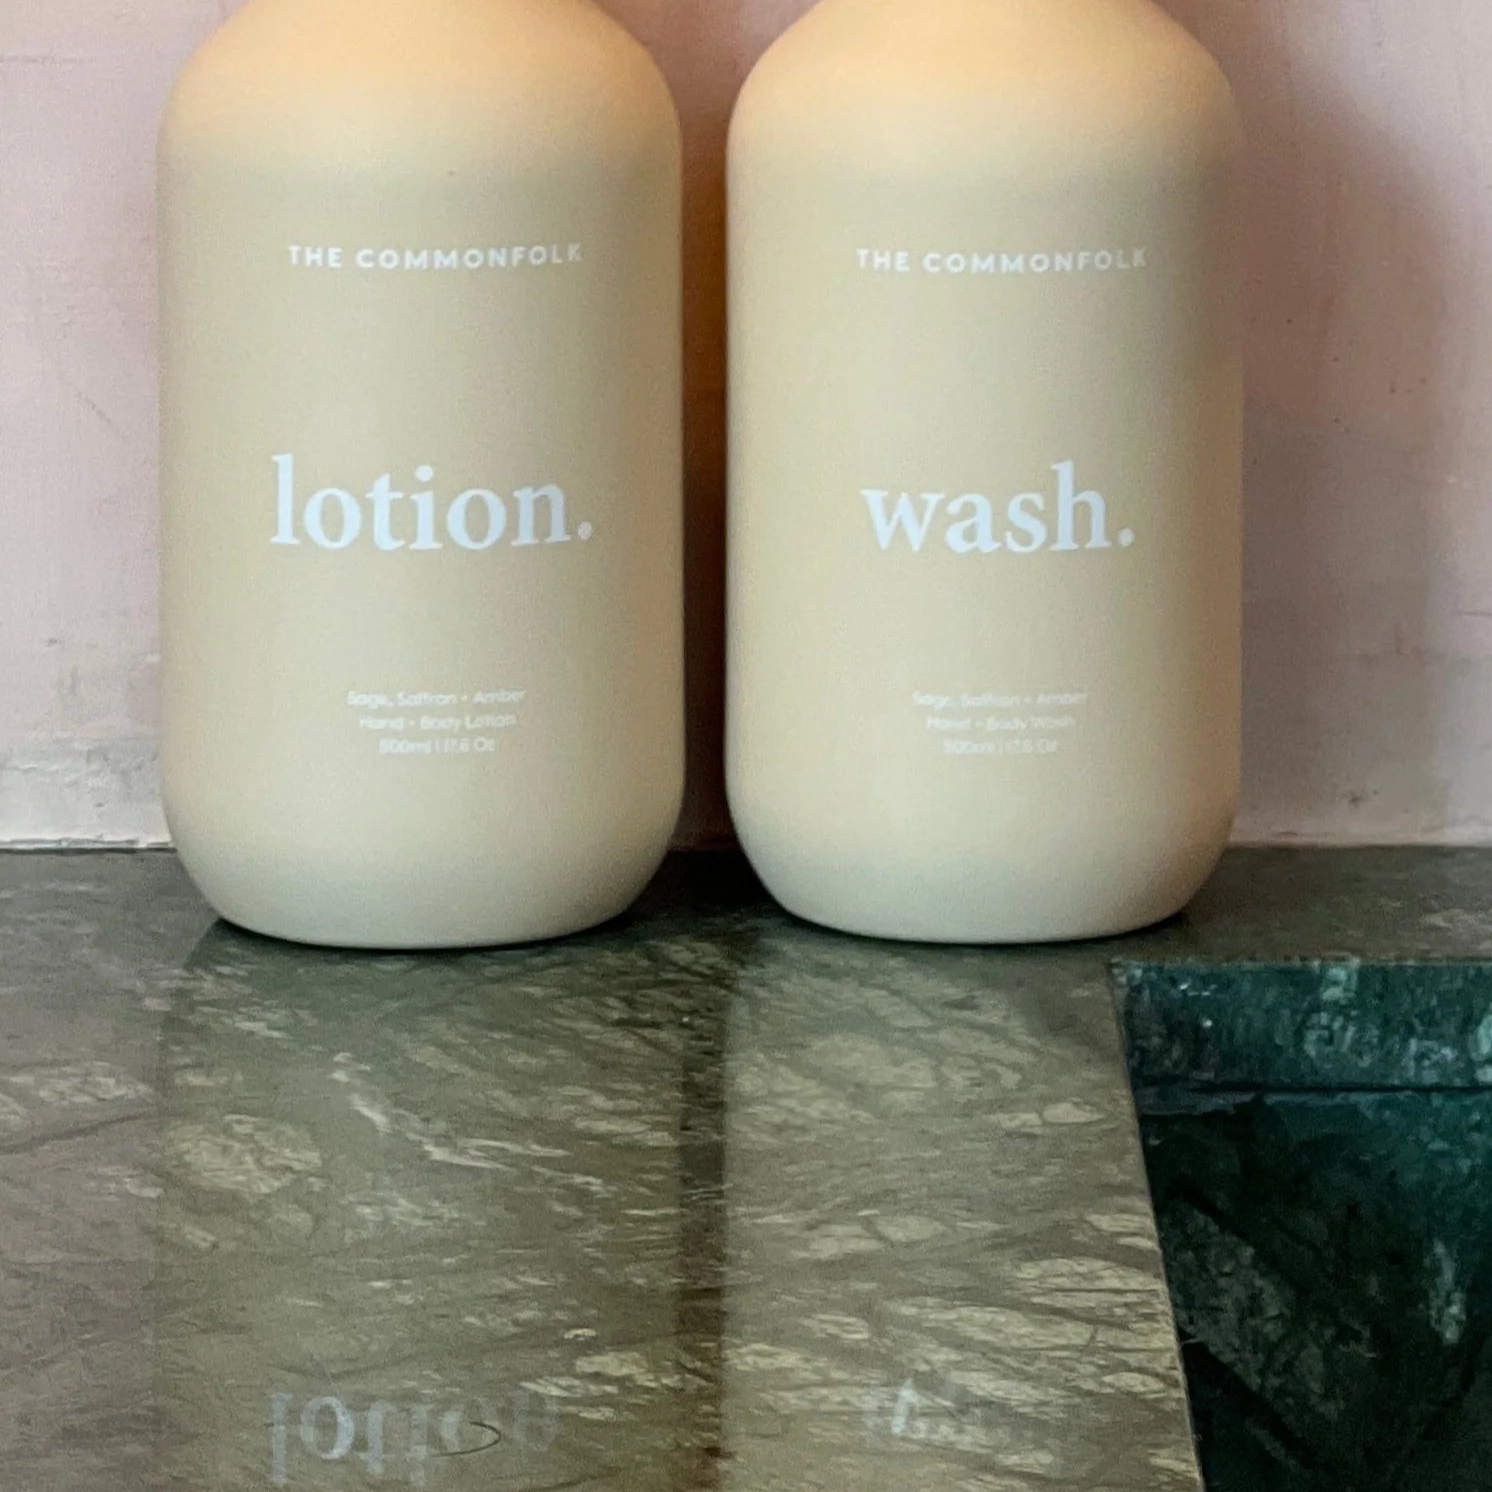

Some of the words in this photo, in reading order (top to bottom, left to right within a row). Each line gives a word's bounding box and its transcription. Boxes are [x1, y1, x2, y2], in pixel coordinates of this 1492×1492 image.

[288, 245, 342, 269] THE
[355, 243, 582, 270] COMMONFOLK
[856, 248, 910, 272] THE
[922, 248, 1148, 274] COMMONFOLK
[270, 453, 594, 551] lotion.
[860, 460, 1136, 554] wash.
